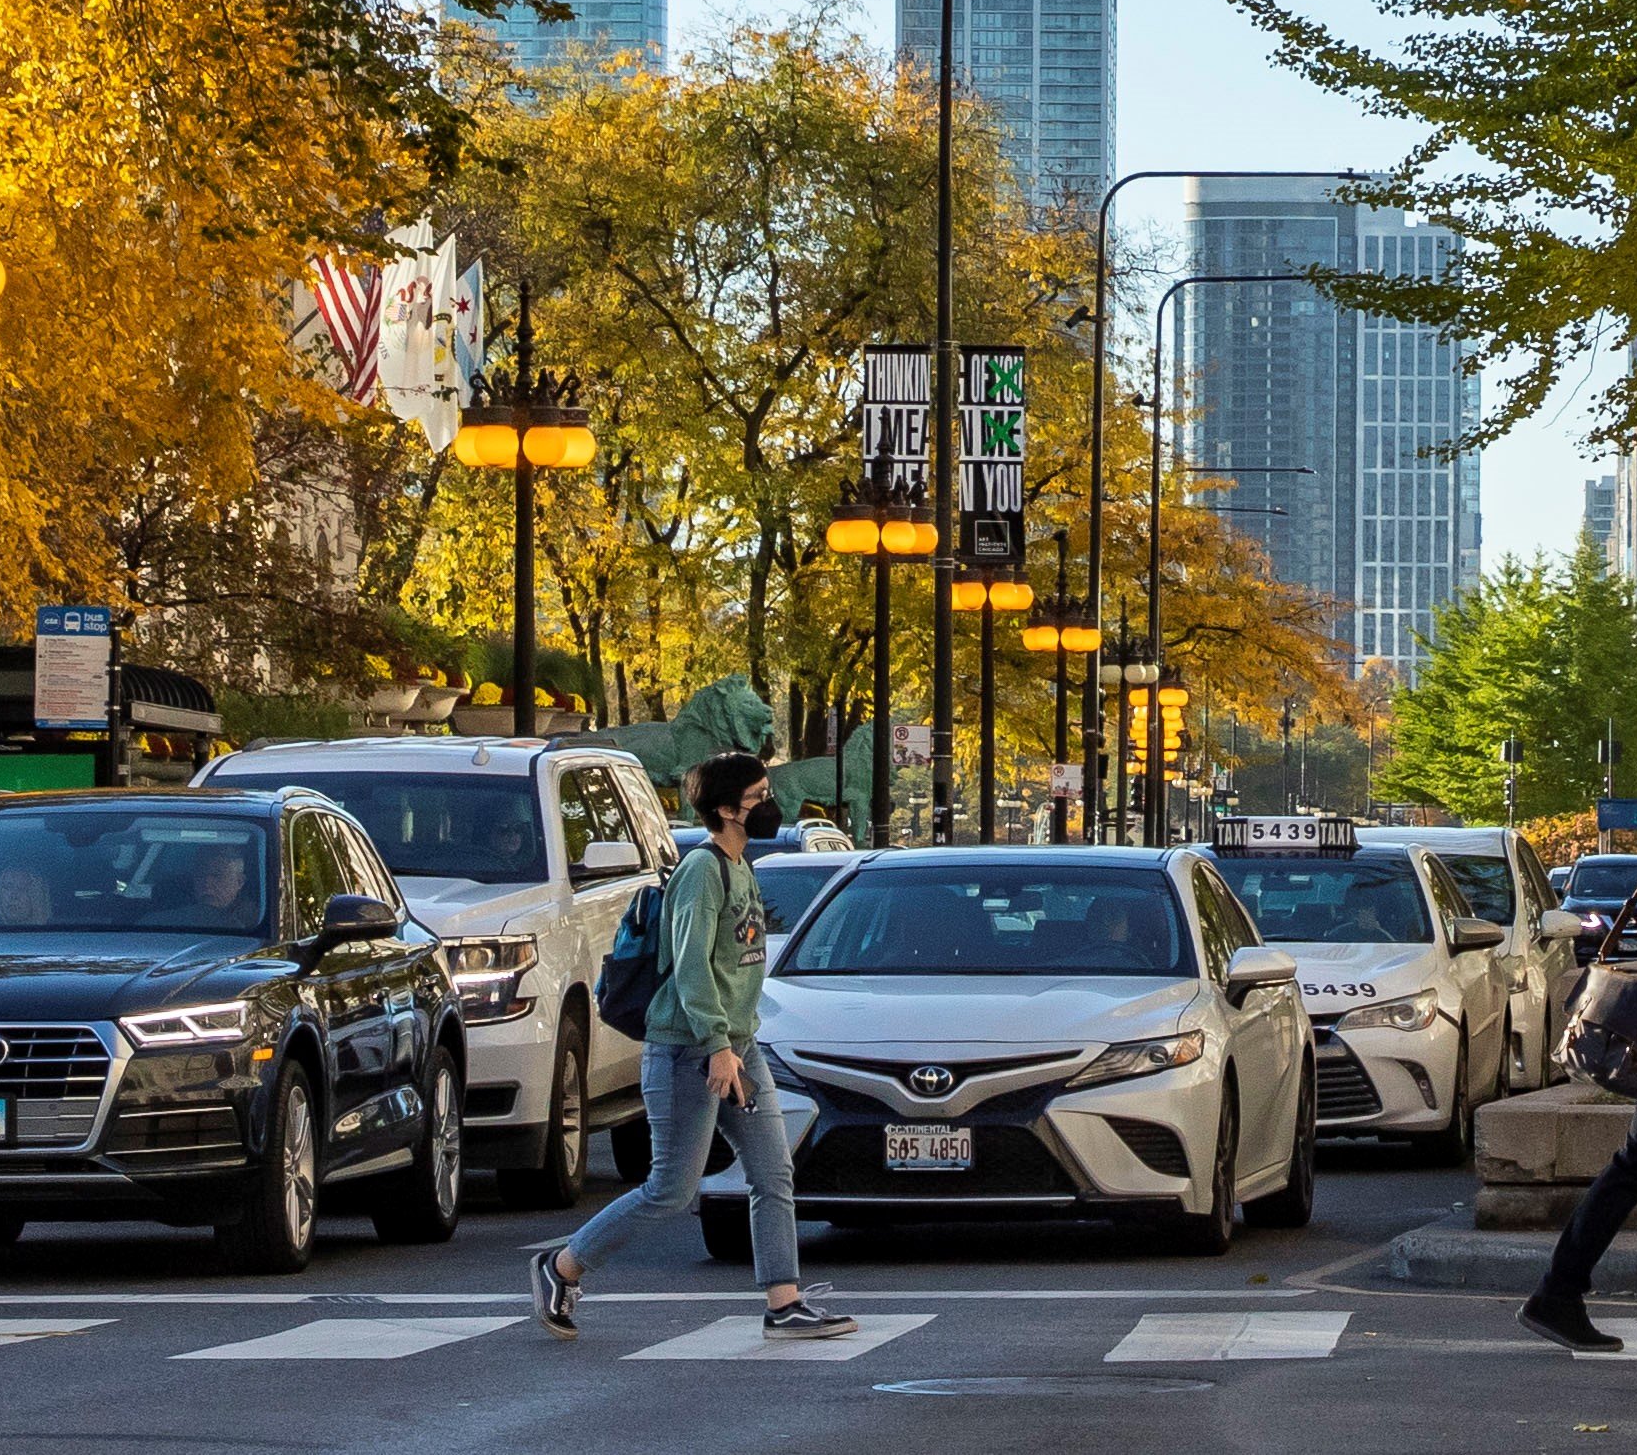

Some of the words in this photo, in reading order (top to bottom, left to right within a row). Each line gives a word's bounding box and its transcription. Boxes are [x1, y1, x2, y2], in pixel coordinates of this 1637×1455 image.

[971, 354, 989, 402] OF
[982, 463, 1022, 512] YOU
[83, 623, 107, 633] stop
[84, 613, 104, 622] bus
[1217, 822, 1248, 846] TAXI
[1252, 823, 1317, 839] 5439
[1320, 822, 1351, 846] TAXI
[1303, 983, 1377, 998] 5439
[929, 1138, 970, 1160] 4850
